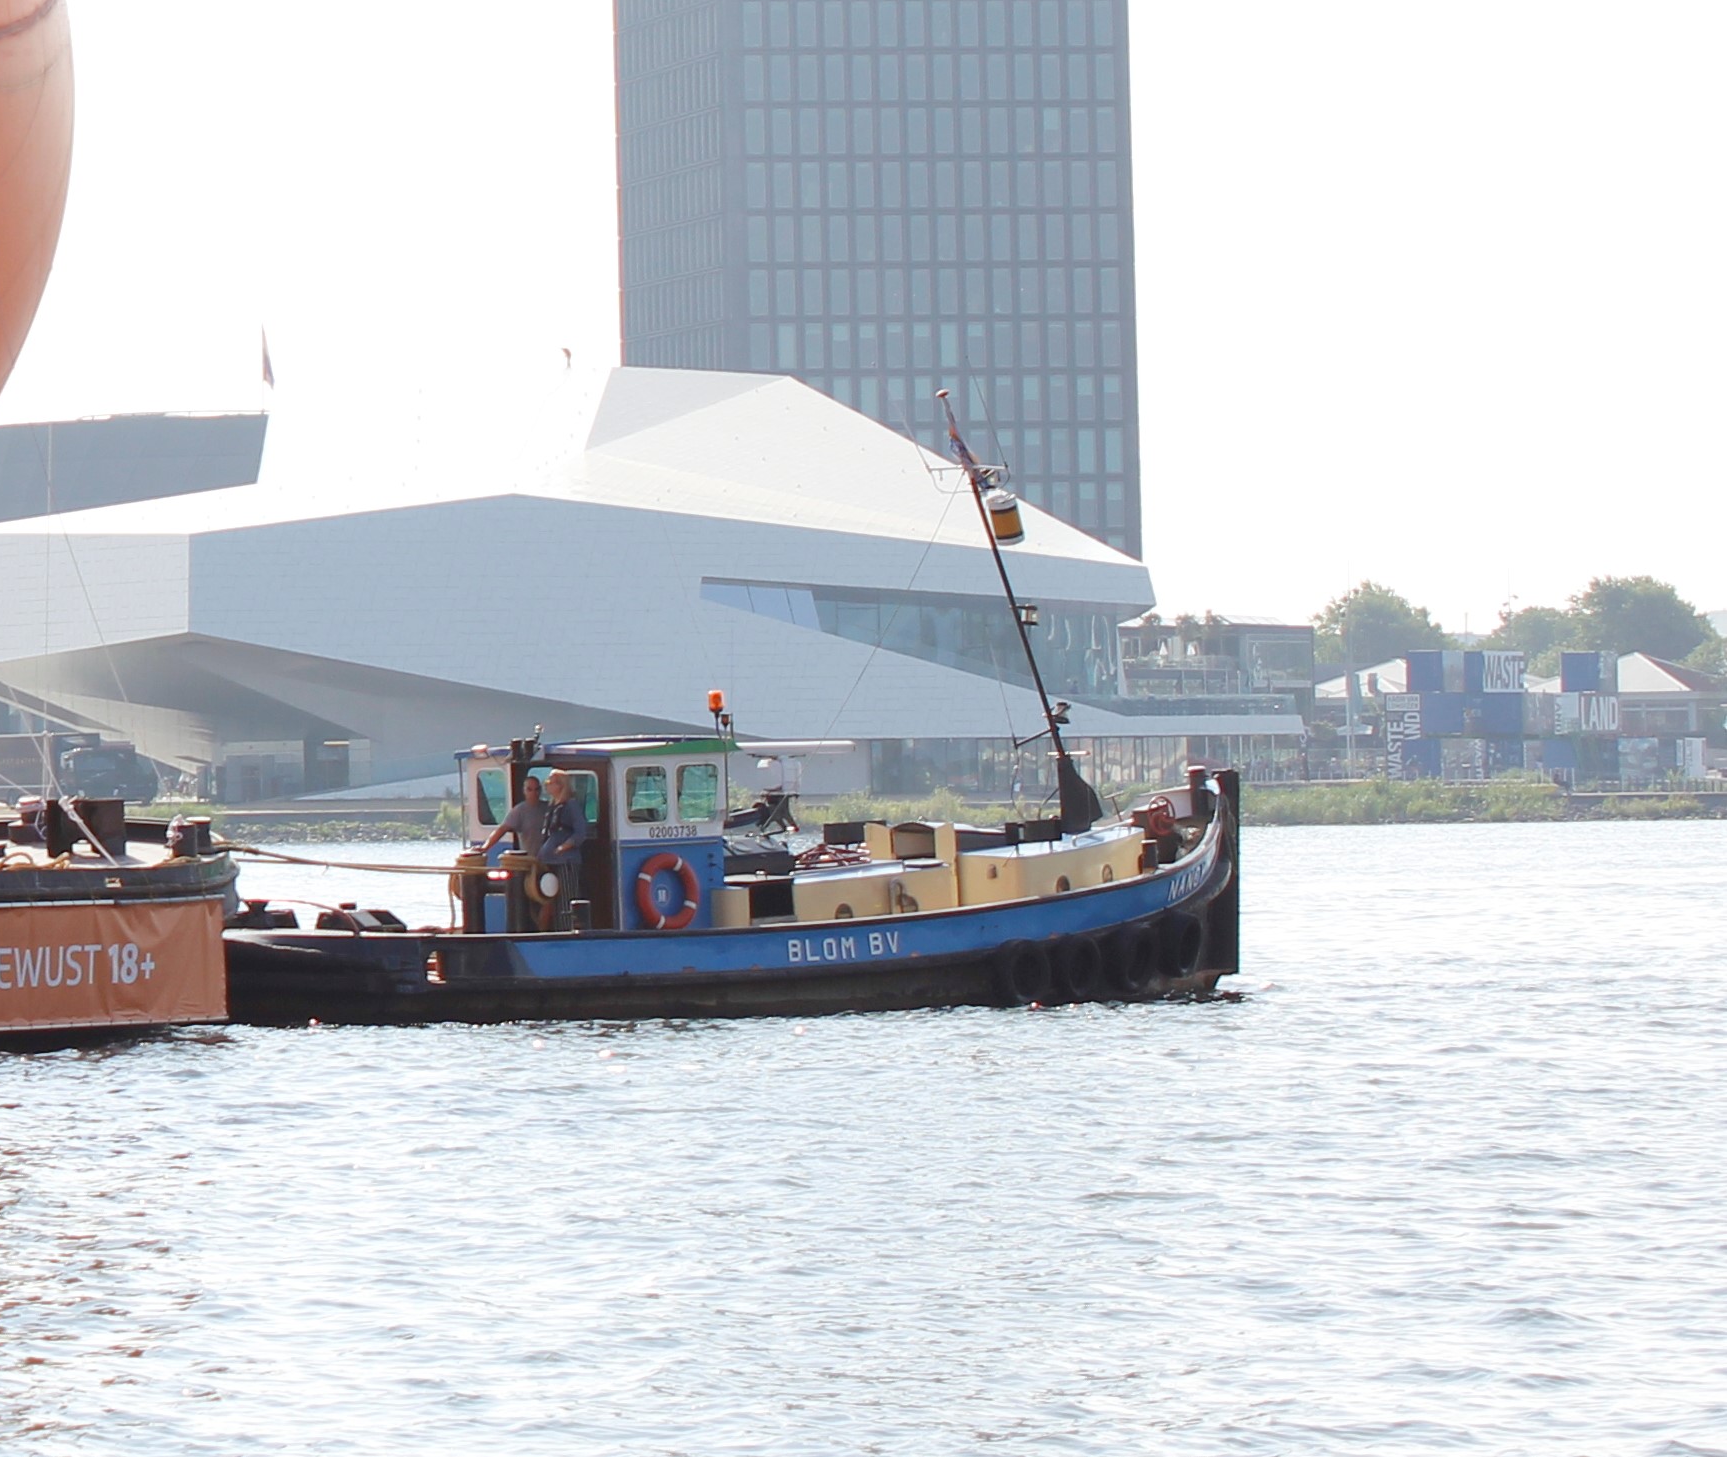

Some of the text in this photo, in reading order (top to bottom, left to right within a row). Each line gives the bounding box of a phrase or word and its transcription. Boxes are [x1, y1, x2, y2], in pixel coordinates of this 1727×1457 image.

[1484, 654, 1525, 690] WASTE
[1581, 696, 1619, 731] LAND
[1387, 721, 1404, 780] WASTE
[649, 825, 698, 839] 02003738
[108, 943, 155, 985] 18+
[787, 931, 898, 962] BLOM BV
